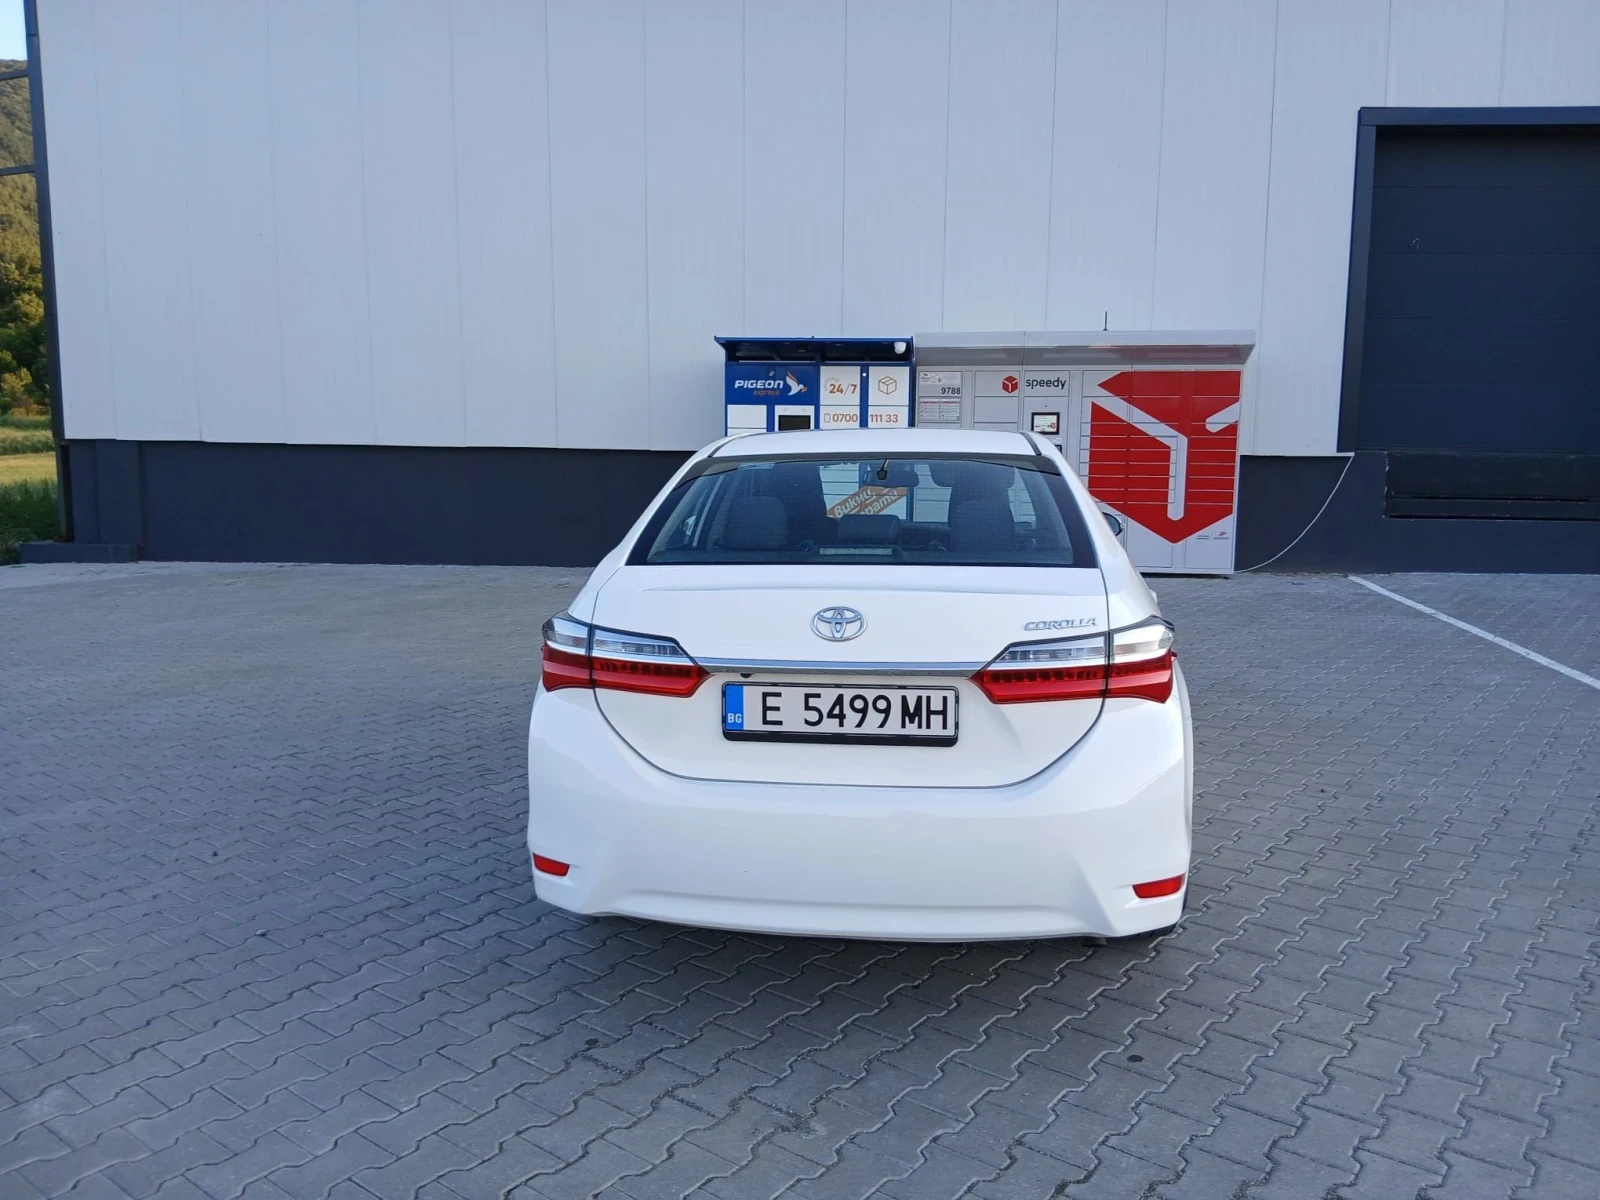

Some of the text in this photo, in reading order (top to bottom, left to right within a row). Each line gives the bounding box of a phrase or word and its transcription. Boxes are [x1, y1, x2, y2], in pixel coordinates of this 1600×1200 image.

[829, 383, 858, 395] 24/7
[1026, 377, 1067, 390] speedy
[941, 387, 961, 395] 9788
[832, 414, 899, 423] 0700 111 33
[1024, 617, 1098, 631] COROLLA
[762, 692, 949, 730] E 5499 MH
[727, 714, 742, 724] BG
